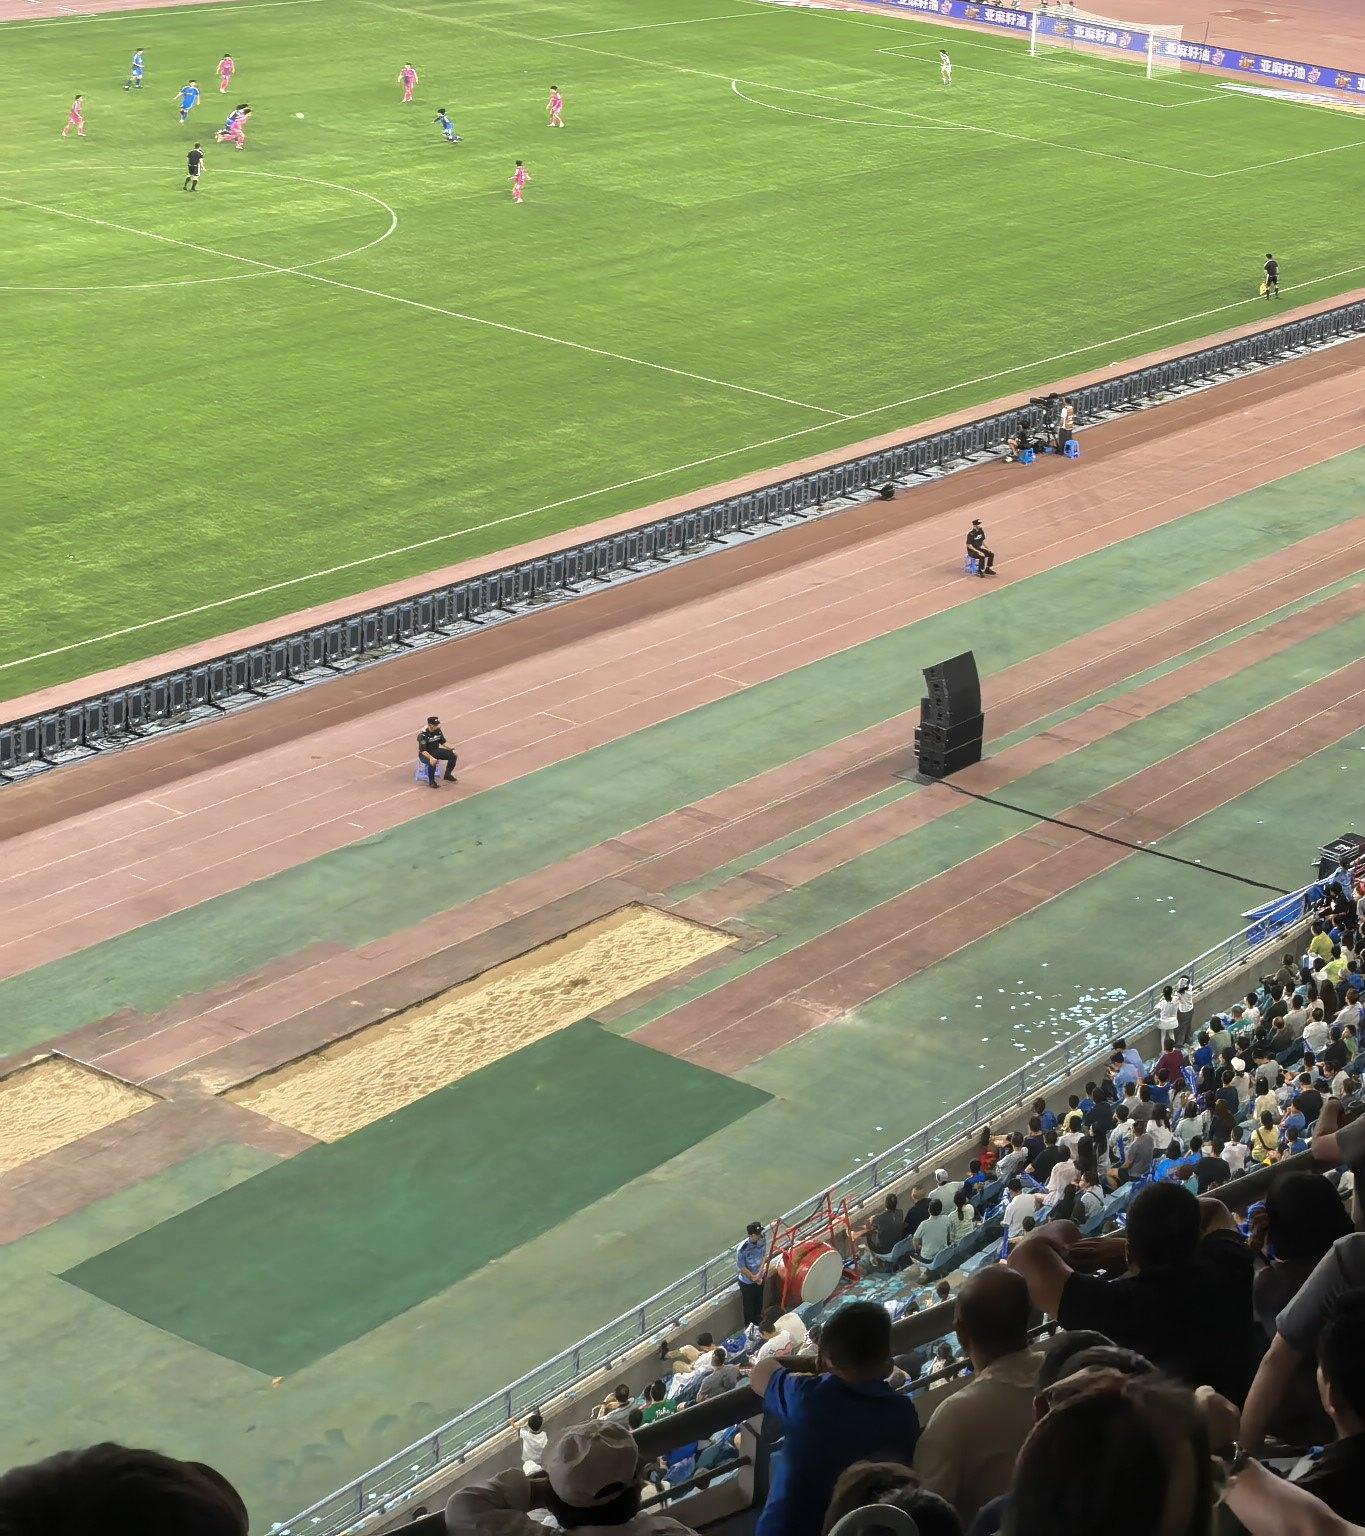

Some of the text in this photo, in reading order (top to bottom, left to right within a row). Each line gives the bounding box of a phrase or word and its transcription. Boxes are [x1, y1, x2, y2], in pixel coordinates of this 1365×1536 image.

[983, 8, 1027, 29] 亚麻籽油
[1072, 26, 1118, 46] 亚麻籽油
[1259, 59, 1306, 80] 亚麻籽油
